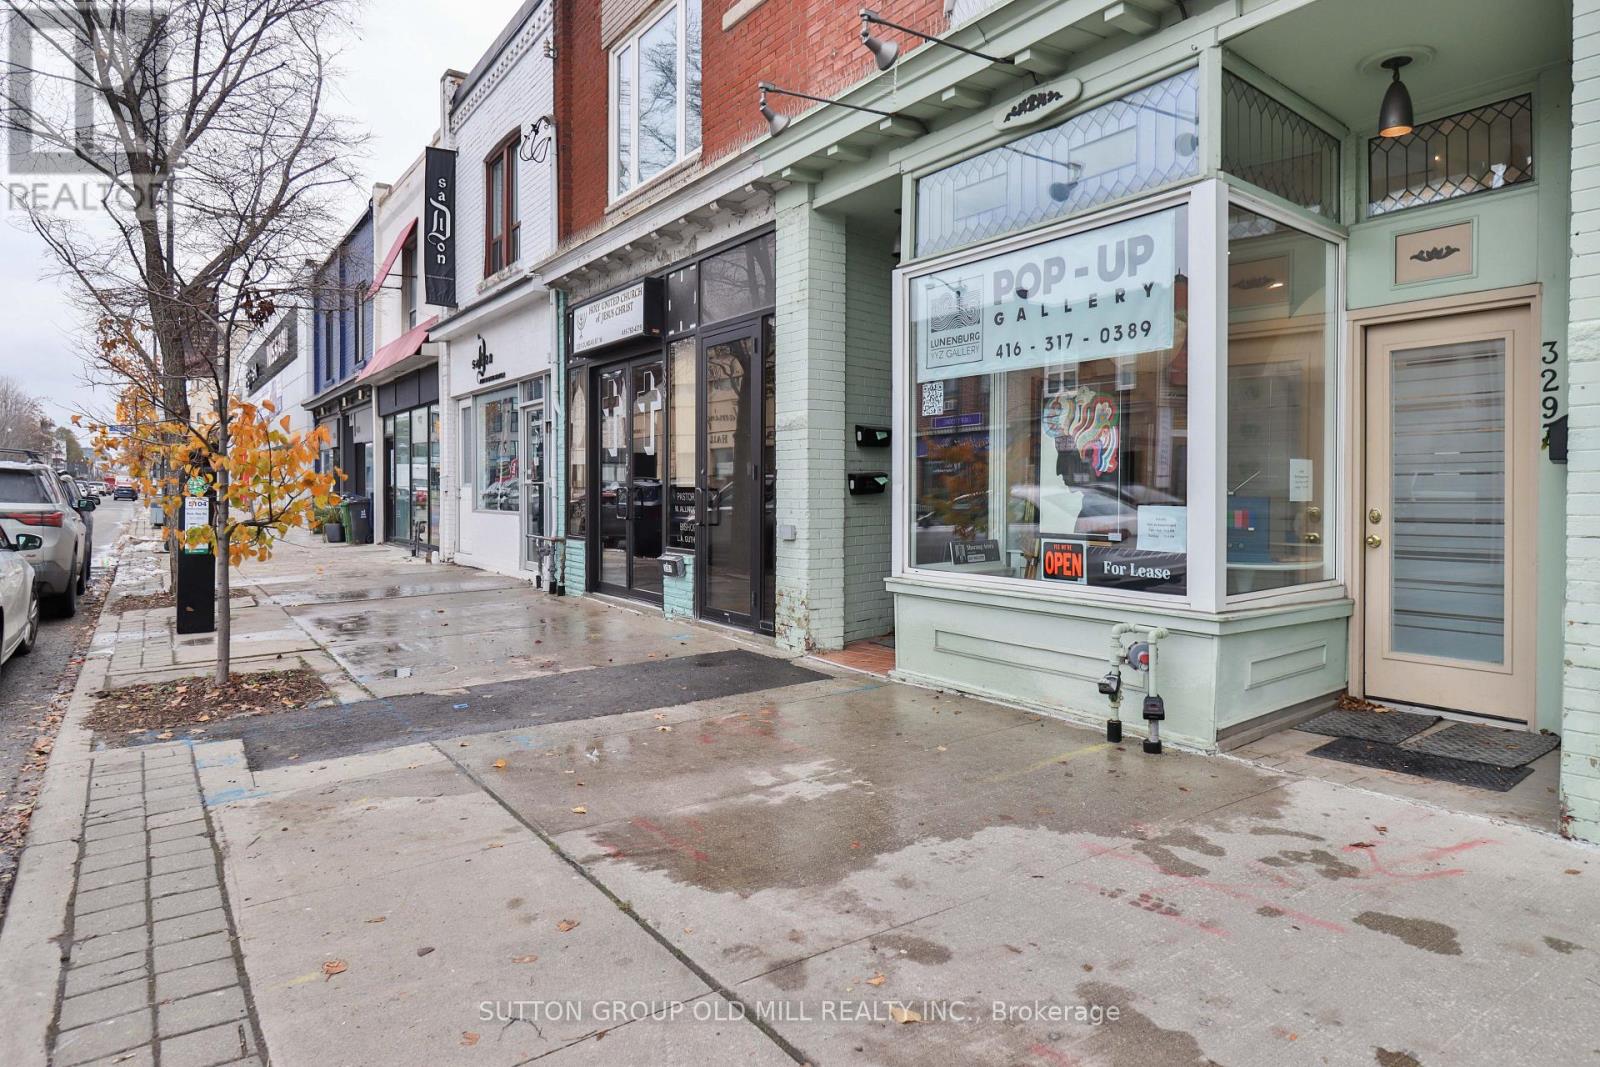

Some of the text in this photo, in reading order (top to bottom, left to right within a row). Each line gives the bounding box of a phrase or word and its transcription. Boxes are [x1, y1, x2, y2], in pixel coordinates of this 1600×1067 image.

[621, 287, 643, 301] CHURCH
[993, 282, 1155, 327] GALLERY
[929, 331, 981, 349] LUNENBURG
[1541, 340, 1560, 446] 329
[1045, 550, 1082, 577] OPEN
[1103, 560, 1171, 580] For Lease
